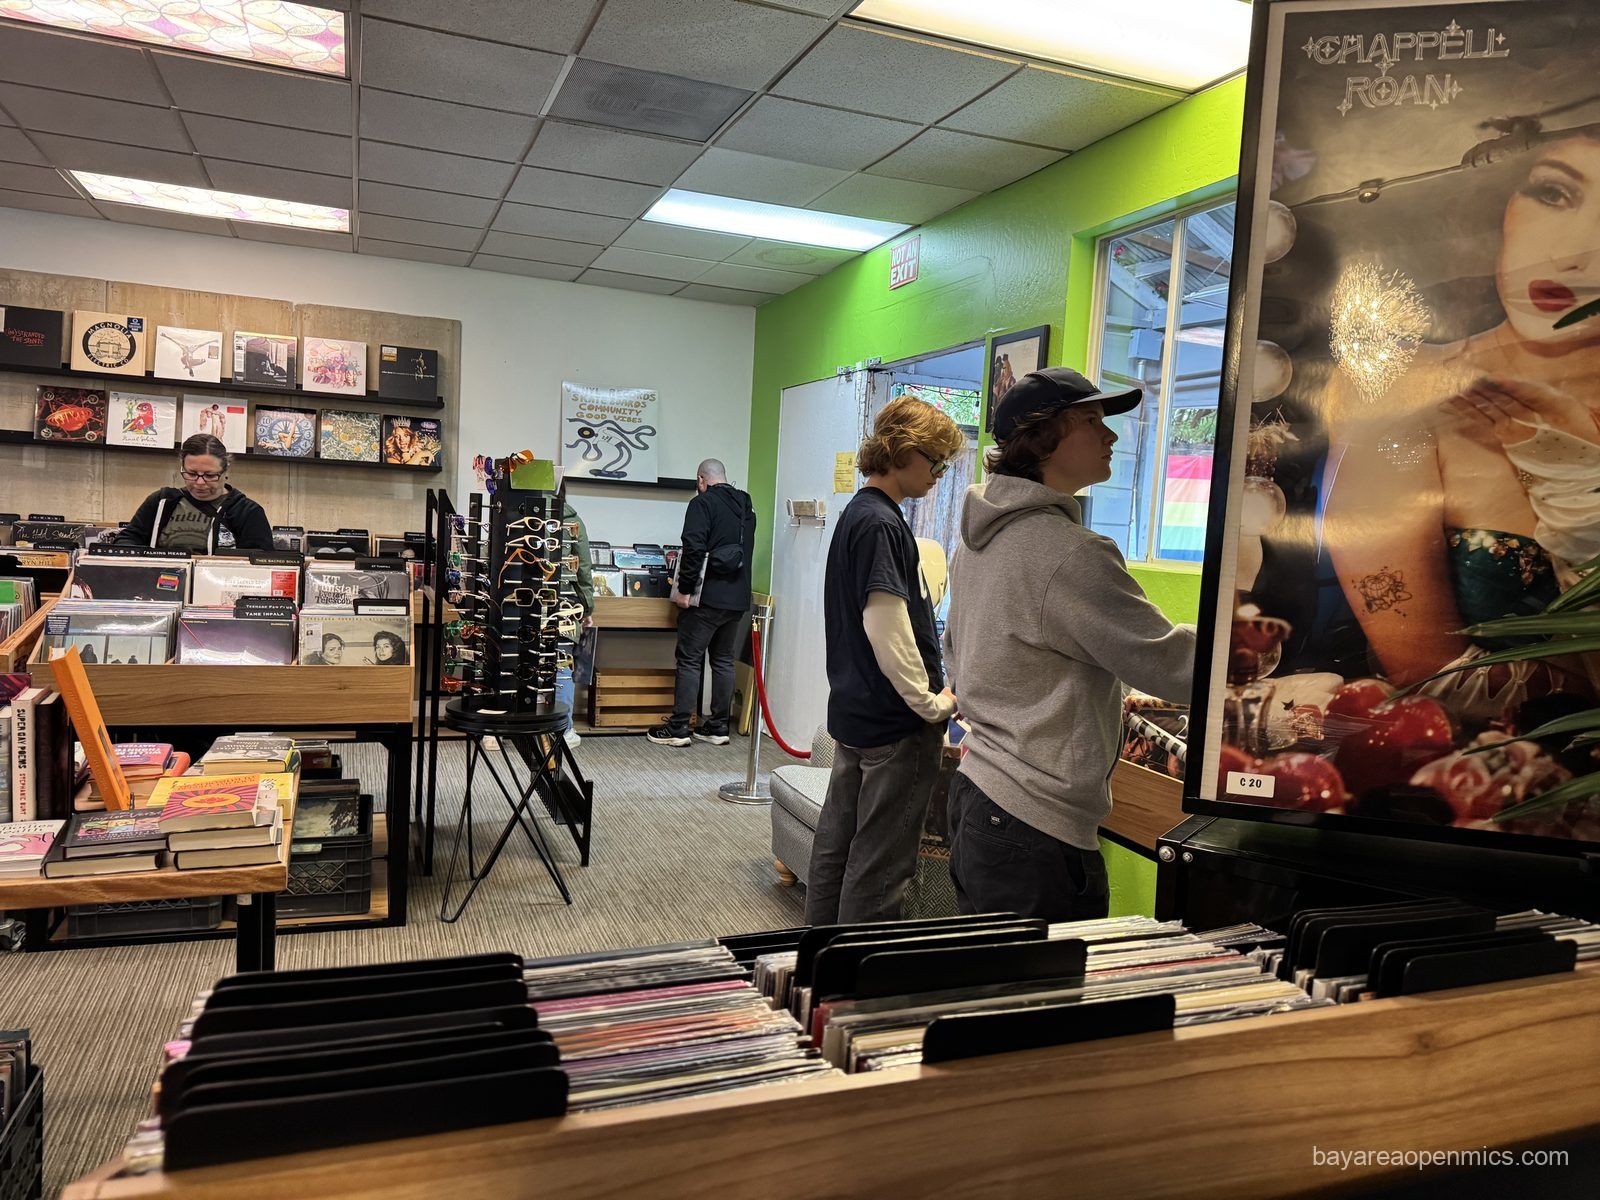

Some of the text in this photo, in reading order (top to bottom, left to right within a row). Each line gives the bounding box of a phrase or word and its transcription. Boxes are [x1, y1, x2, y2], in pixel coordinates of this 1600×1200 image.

[1314, 28, 1510, 64] CHAPPELL
[1344, 74, 1452, 109] ROAN
[891, 240, 918, 268] NOT AN
[890, 260, 917, 286] EXIT
[87, 321, 132, 339] MAGNOLIA
[575, 412, 643, 423] GOOD VIBES
[579, 403, 642, 416] COMMUNITY
[322, 574, 341, 585] KT
[17, 709, 26, 731] SUPER
[17, 731, 26, 745] GAY
[18, 746, 27, 769] POEMS
[1240, 777, 1262, 788] C 20
